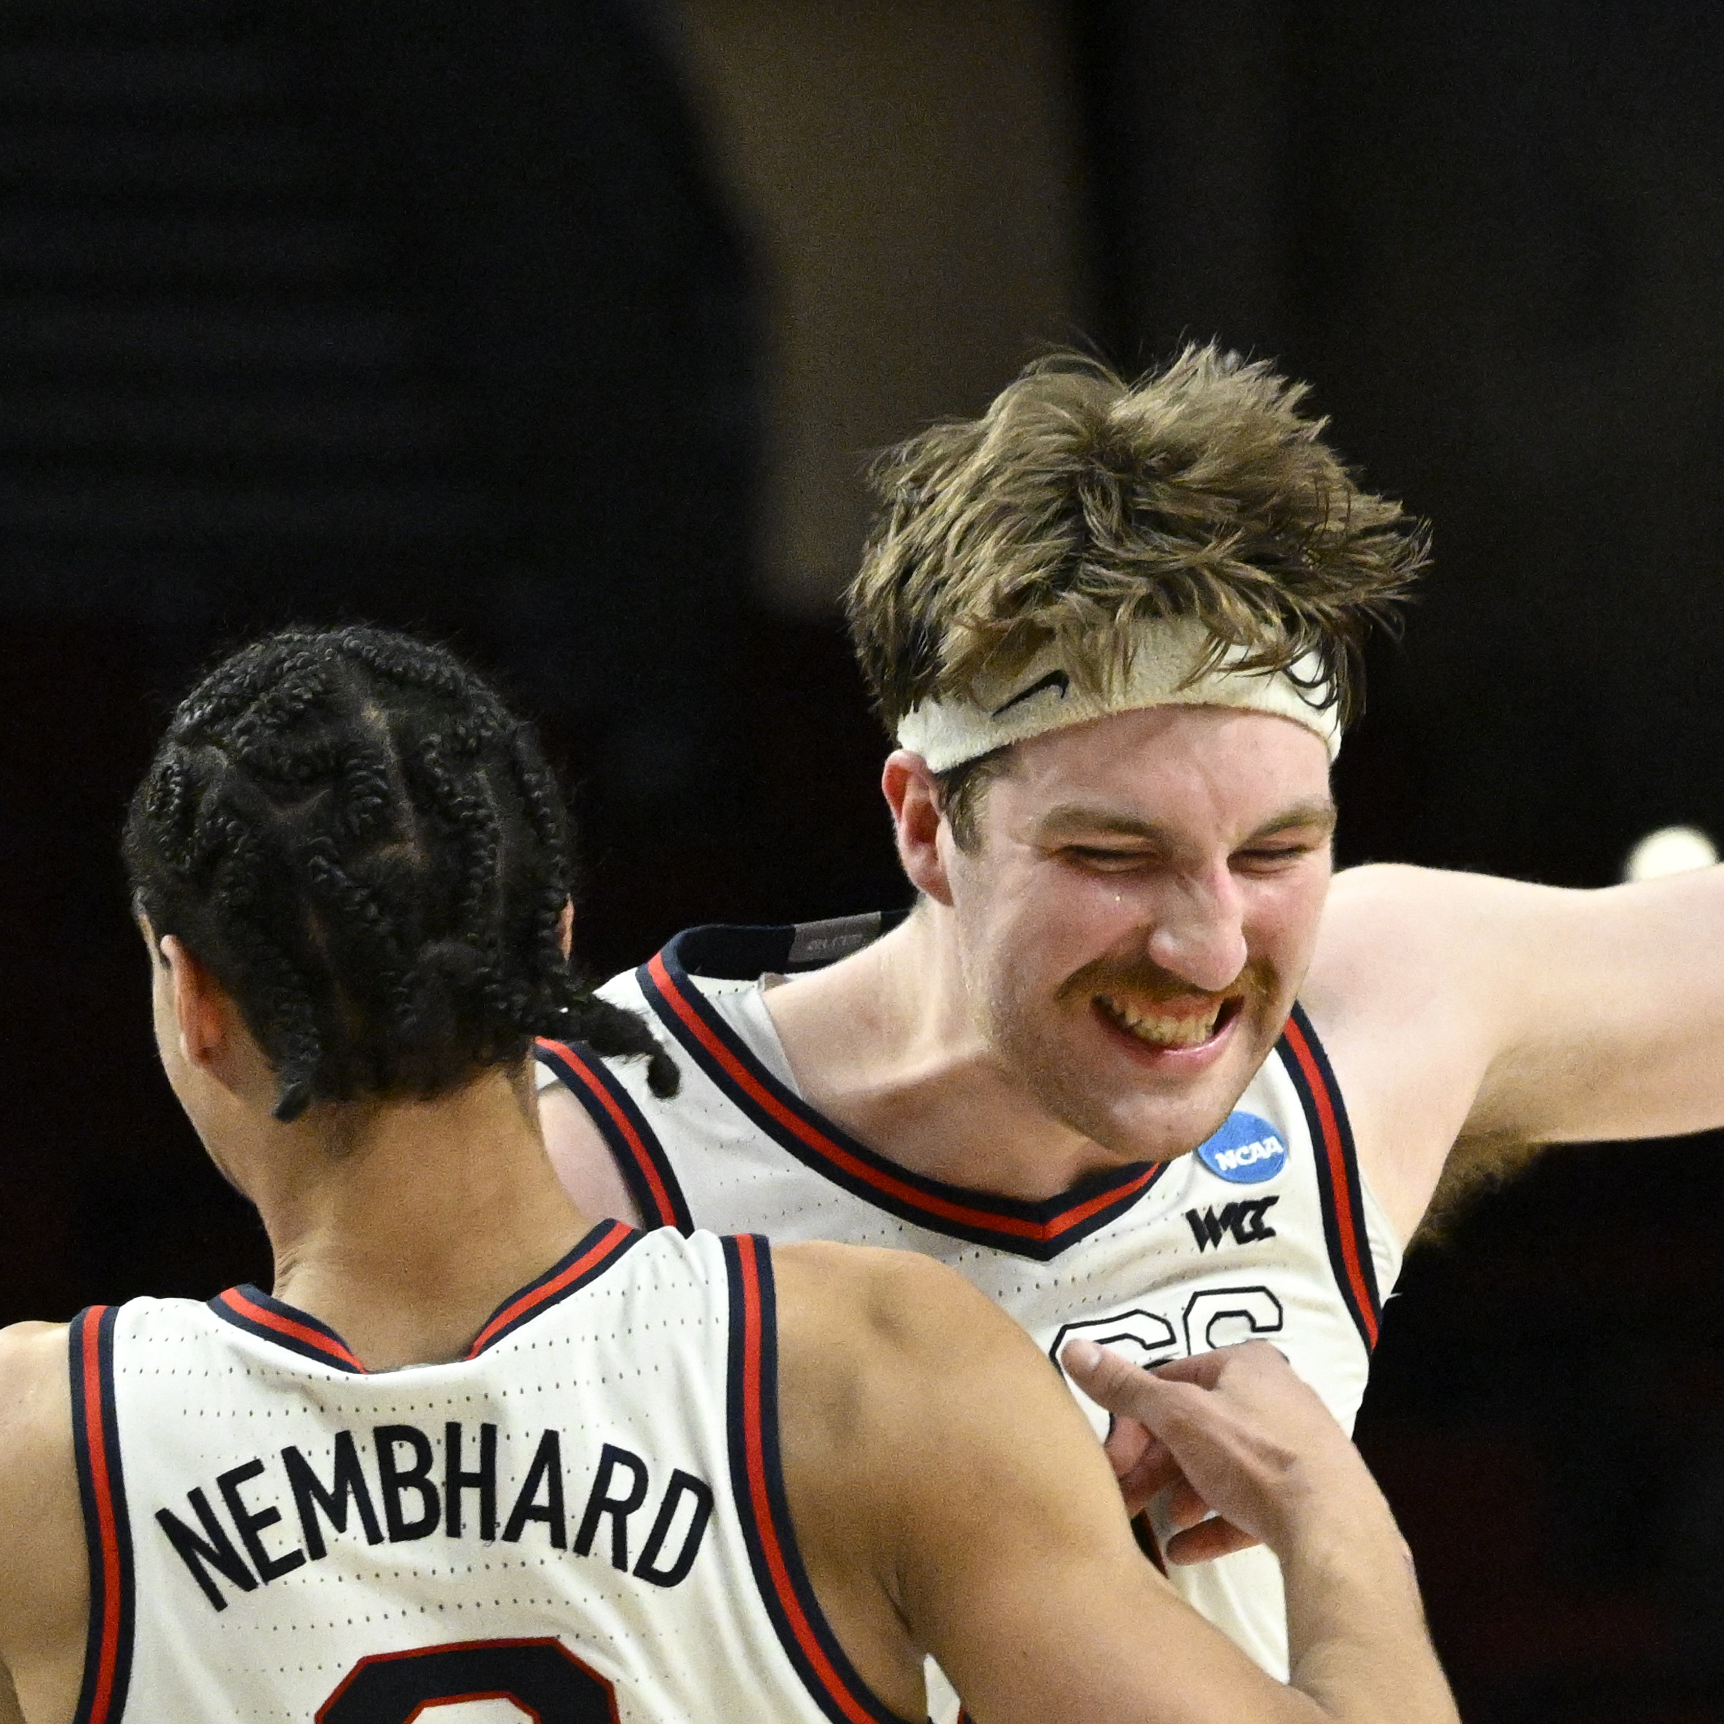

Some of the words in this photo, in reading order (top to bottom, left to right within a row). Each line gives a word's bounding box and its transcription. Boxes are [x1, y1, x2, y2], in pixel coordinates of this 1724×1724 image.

[1214, 1136, 1285, 1171] NCAA
[1185, 1195, 1280, 1253] WCC
[155, 1422, 715, 1612] NEMBHARD
